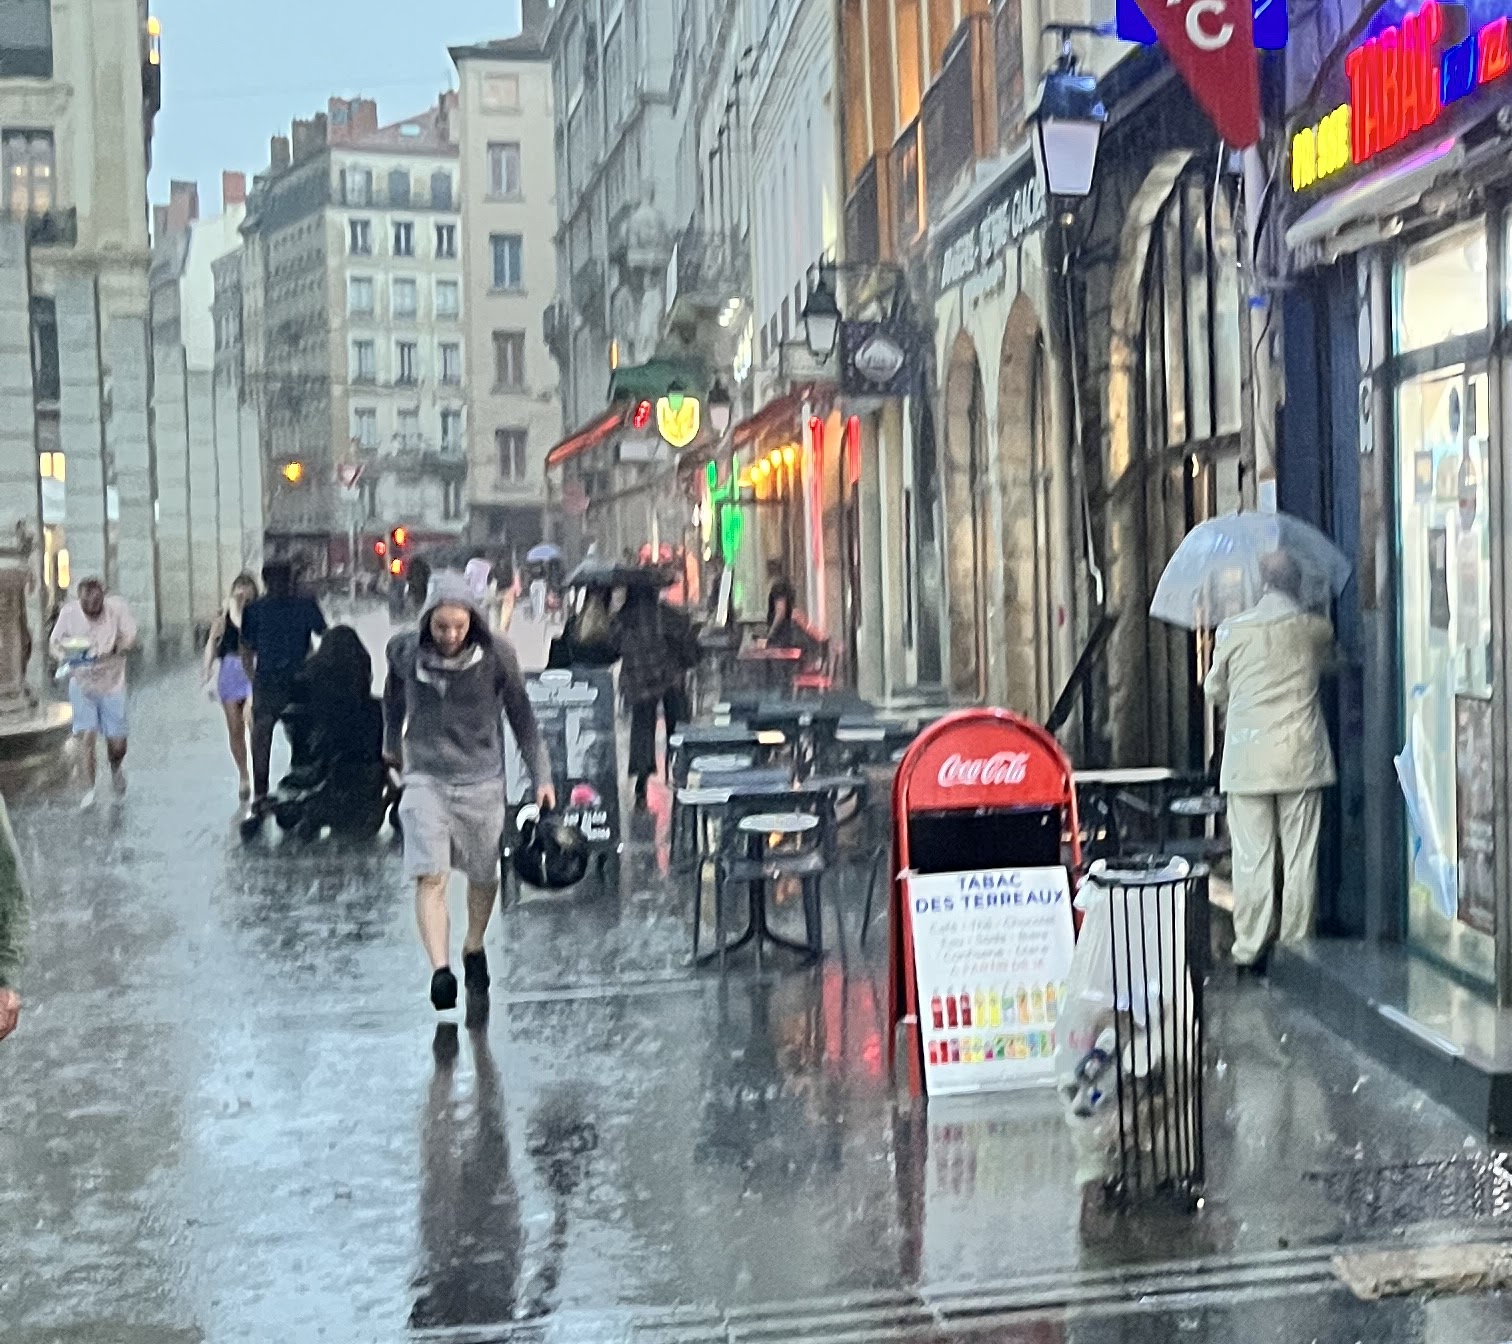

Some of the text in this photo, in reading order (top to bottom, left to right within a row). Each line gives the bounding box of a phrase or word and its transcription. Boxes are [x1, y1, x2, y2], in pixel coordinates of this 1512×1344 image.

[958, 870, 1023, 891] TABAC
[915, 887, 1064, 915] DES TERREAUX
